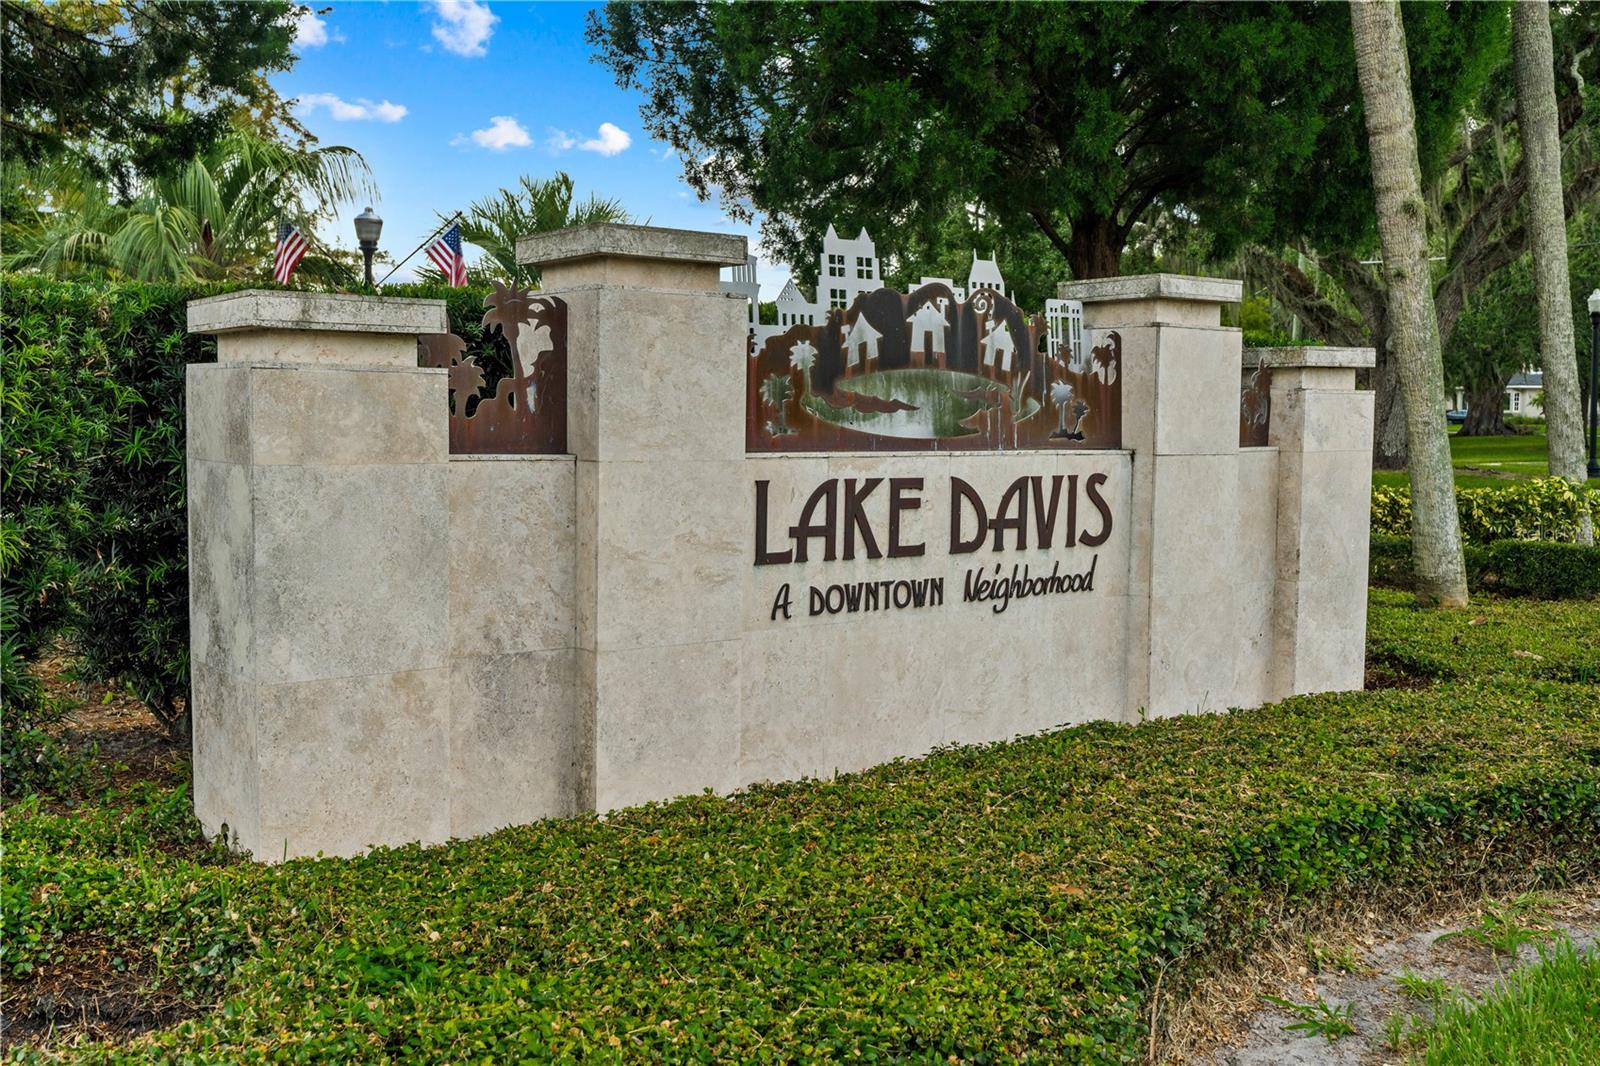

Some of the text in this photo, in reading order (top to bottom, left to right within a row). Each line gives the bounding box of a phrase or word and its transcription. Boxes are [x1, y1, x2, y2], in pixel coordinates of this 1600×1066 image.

[754, 472, 1113, 566] LAKE DAVIS
[771, 554, 1098, 620] A DOWNTOWN Neighborhood
